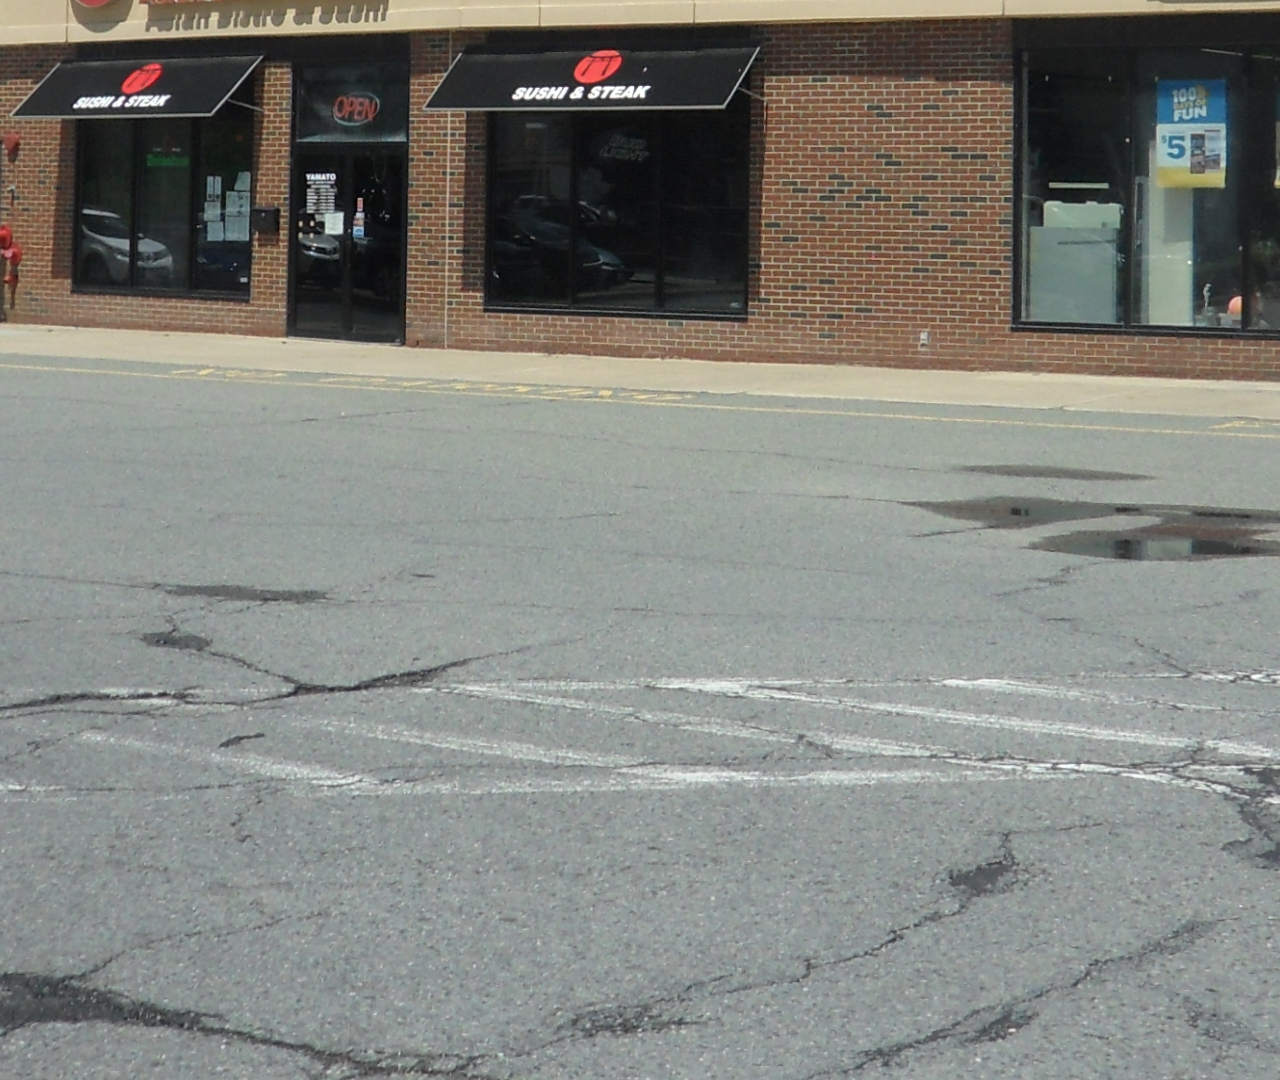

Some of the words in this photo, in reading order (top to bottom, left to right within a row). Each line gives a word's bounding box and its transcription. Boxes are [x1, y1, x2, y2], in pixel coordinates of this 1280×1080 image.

[511, 86, 569, 100] SUSHI
[569, 86, 585, 99] &
[587, 85, 651, 99] STEAK
[1172, 87, 1198, 103] 100
[72, 96, 115, 109] SUSHI
[111, 95, 125, 108] &
[124, 94, 171, 108] STEAK
[334, 95, 377, 121] OPEN
[1173, 106, 1207, 122] FUN
[1161, 135, 1186, 160] $5
[306, 173, 337, 181] YAMATO
